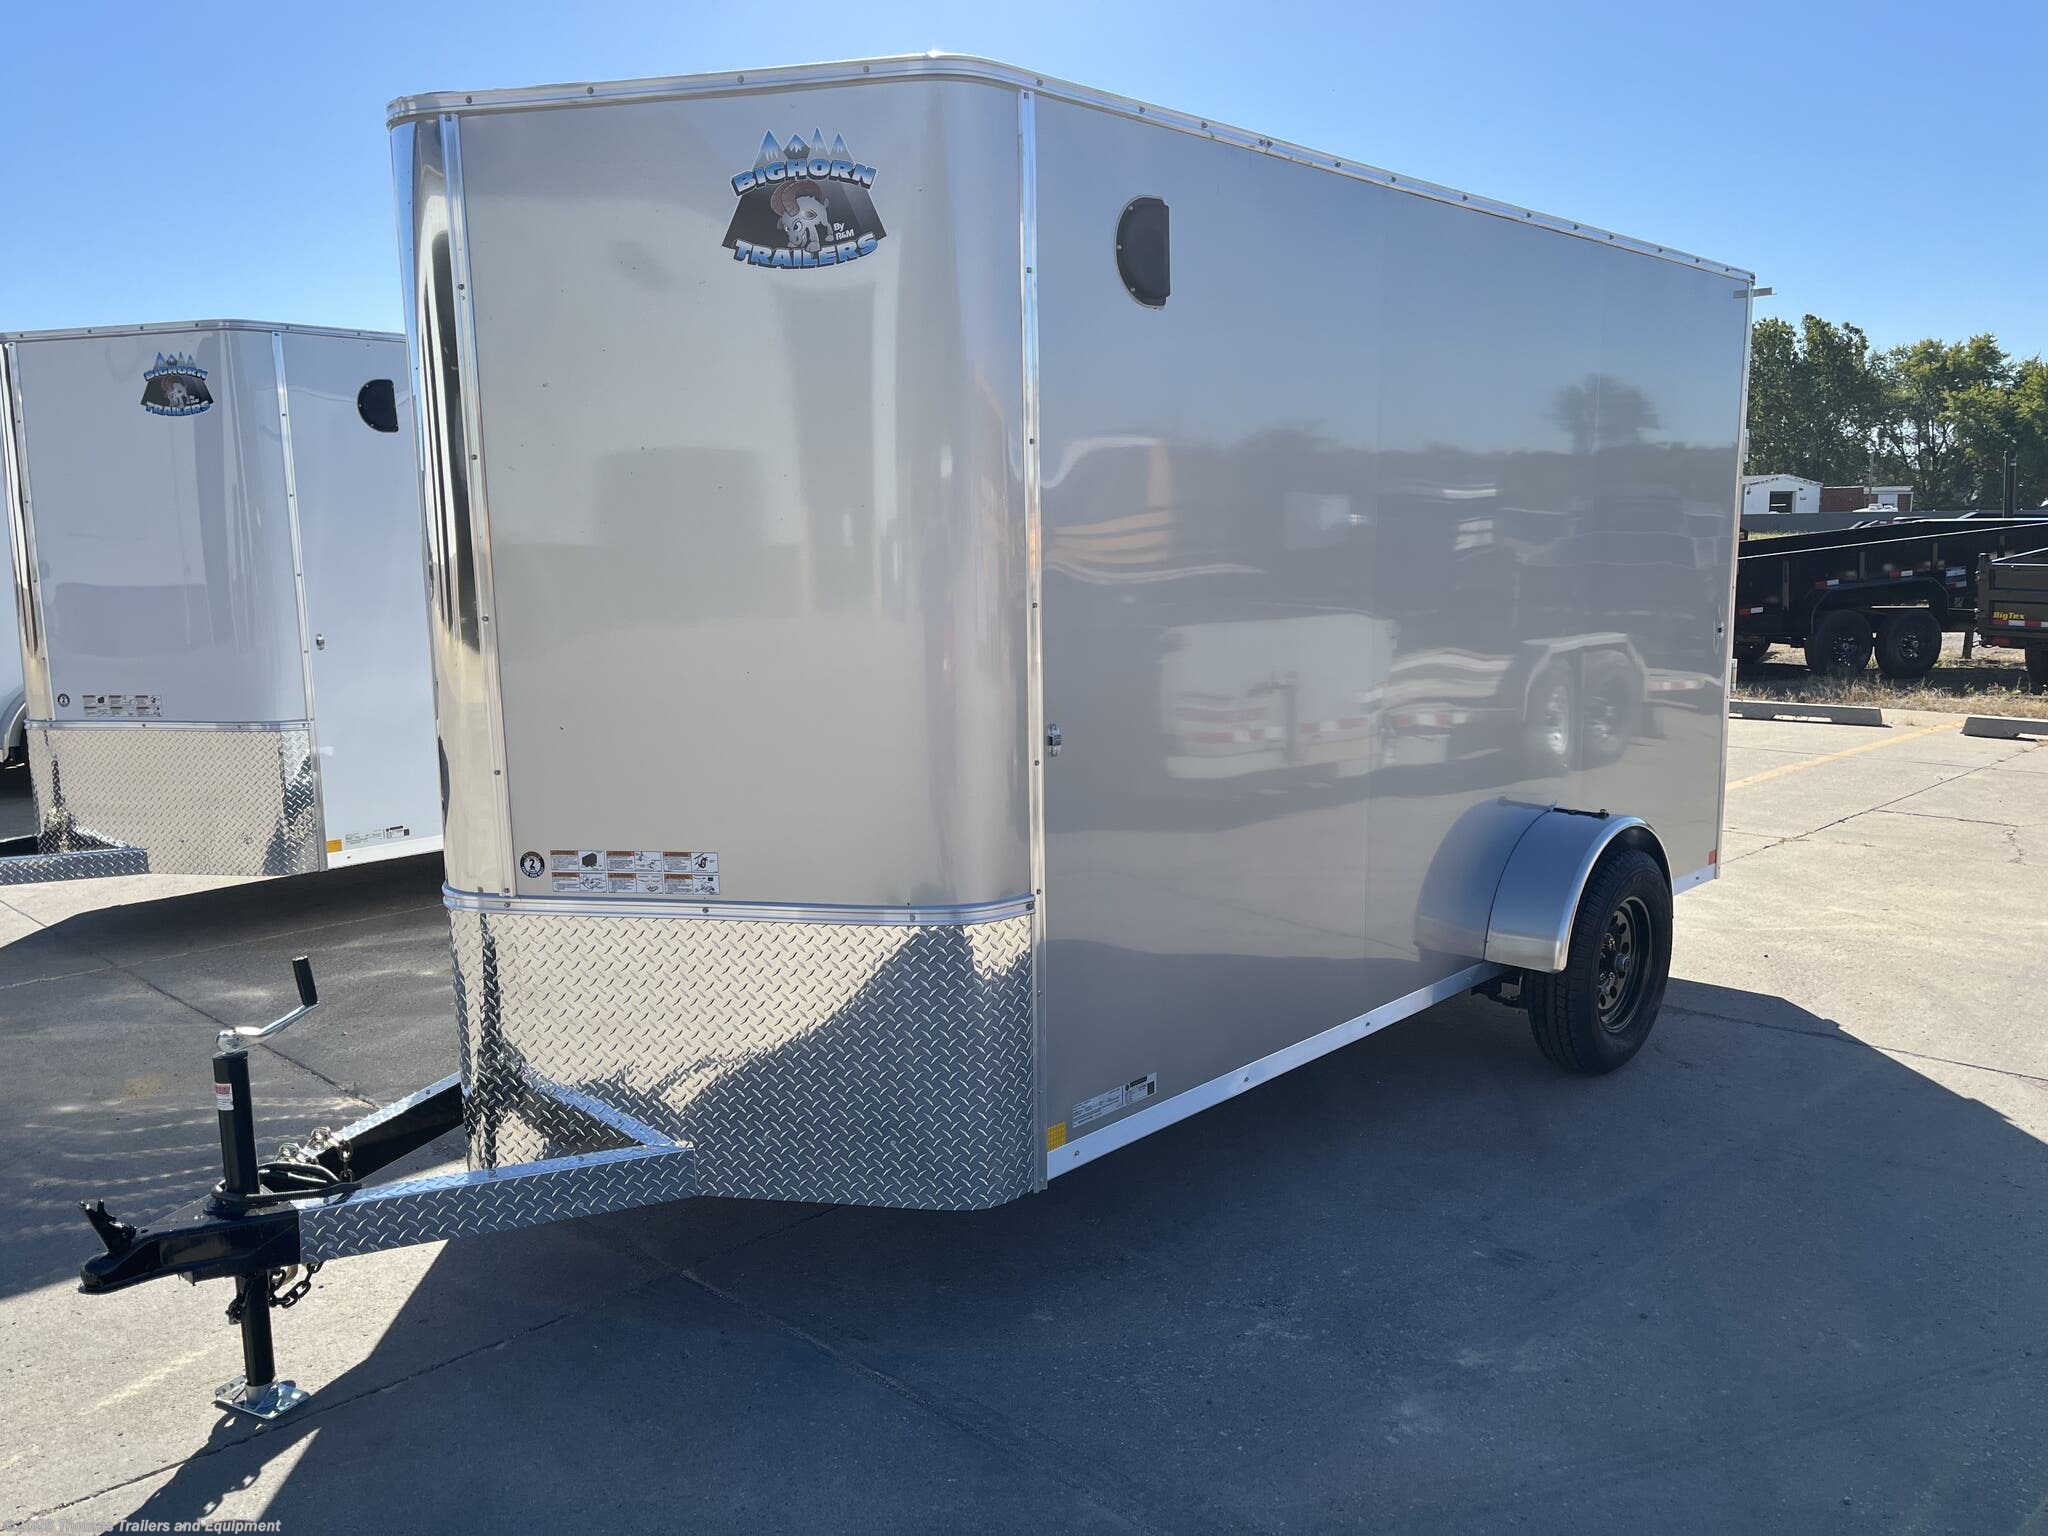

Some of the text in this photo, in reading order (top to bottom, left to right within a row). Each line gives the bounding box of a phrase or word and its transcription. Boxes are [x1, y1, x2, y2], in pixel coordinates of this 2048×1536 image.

[731, 158, 877, 196] BIGHORN
[833, 222, 845, 232] By
[734, 233, 879, 269] TRAILERS
[145, 401, 210, 415] TRAILERS
